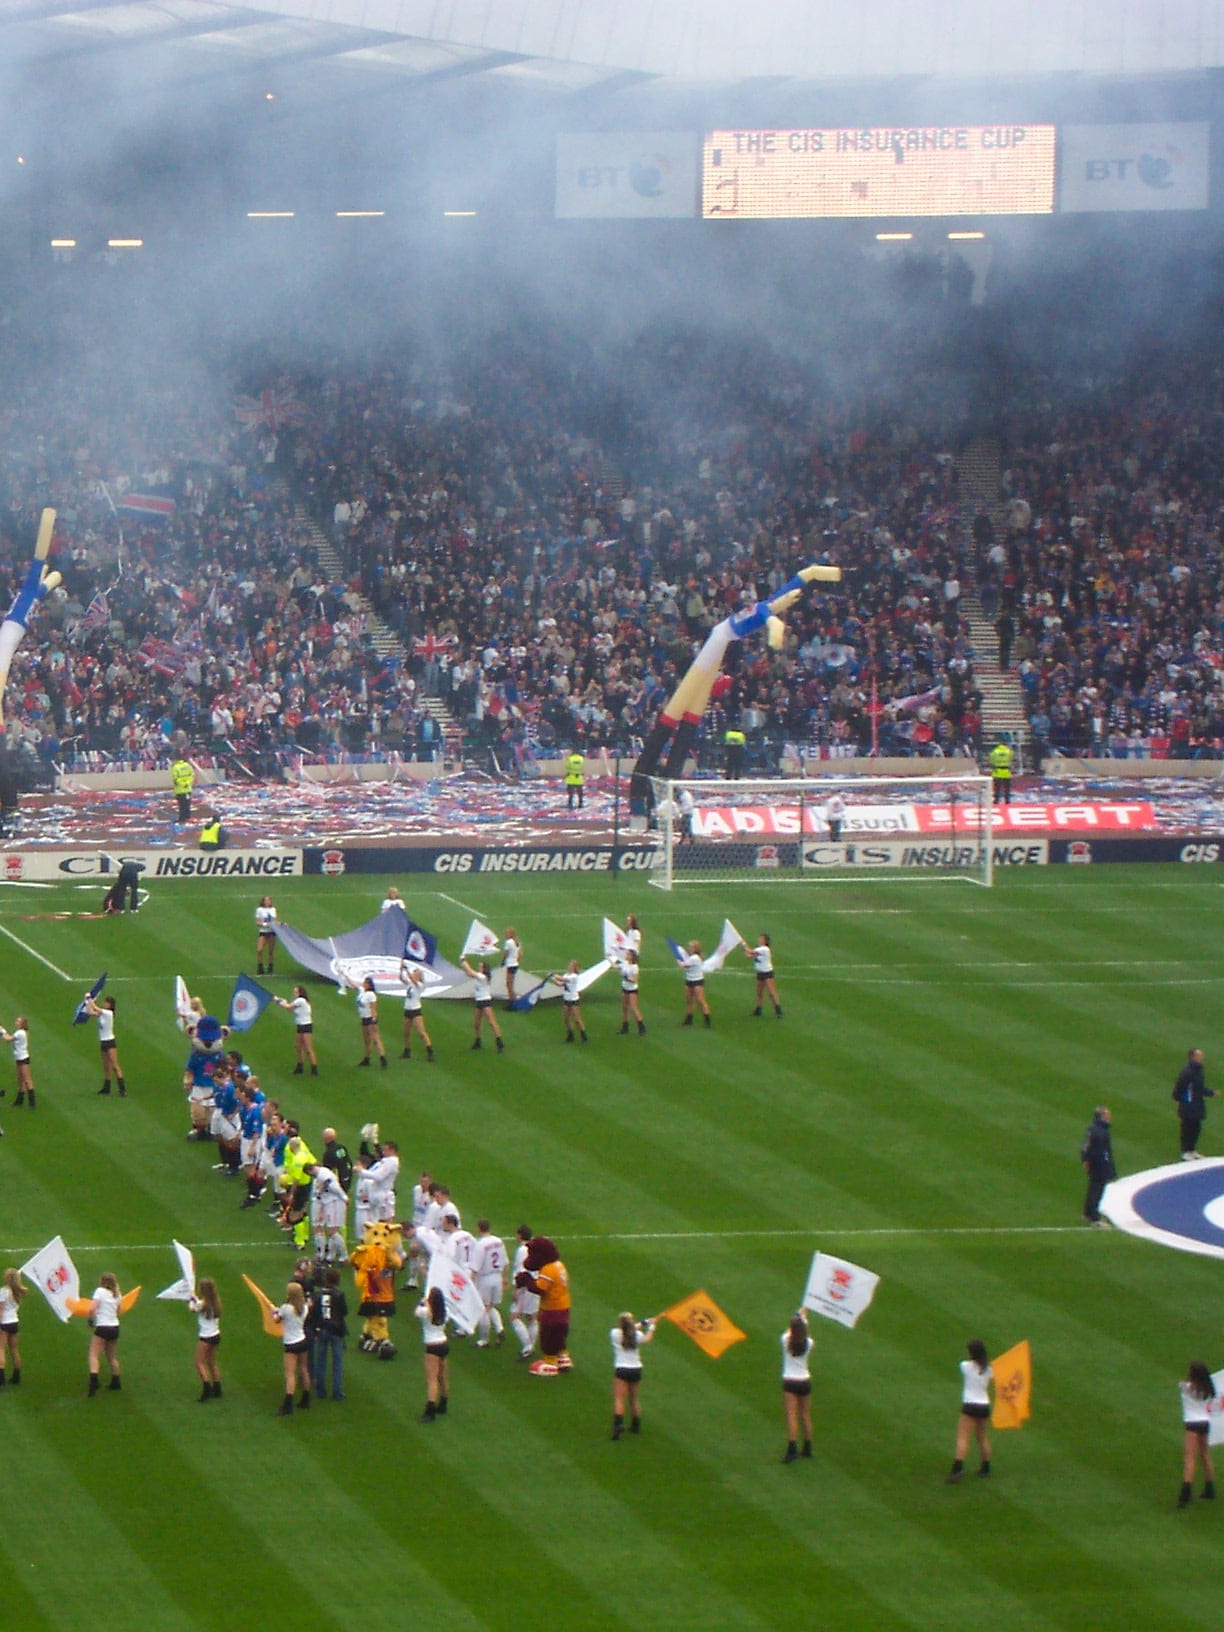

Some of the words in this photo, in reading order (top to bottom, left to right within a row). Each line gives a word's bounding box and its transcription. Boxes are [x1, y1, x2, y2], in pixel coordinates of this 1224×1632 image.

[733, 132, 776, 152] THE
[788, 132, 825, 151] CIS
[836, 129, 968, 151] INSURANCE
[981, 128, 1026, 149] CUP
[577, 166, 624, 188] BT
[1085, 158, 1134, 181] BT
[840, 812, 908, 830] isual
[964, 806, 1142, 827] SEAT
[434, 853, 473, 872] CIS
[479, 852, 612, 872] INSURANCE
[618, 851, 666, 870] CUP
[805, 844, 891, 865] CIS
[901, 845, 1042, 865] INSURANCE
[1180, 844, 1220, 863] CIS
[156, 856, 297, 876] INSURANCE
[491, 1252, 500, 1269] 2
